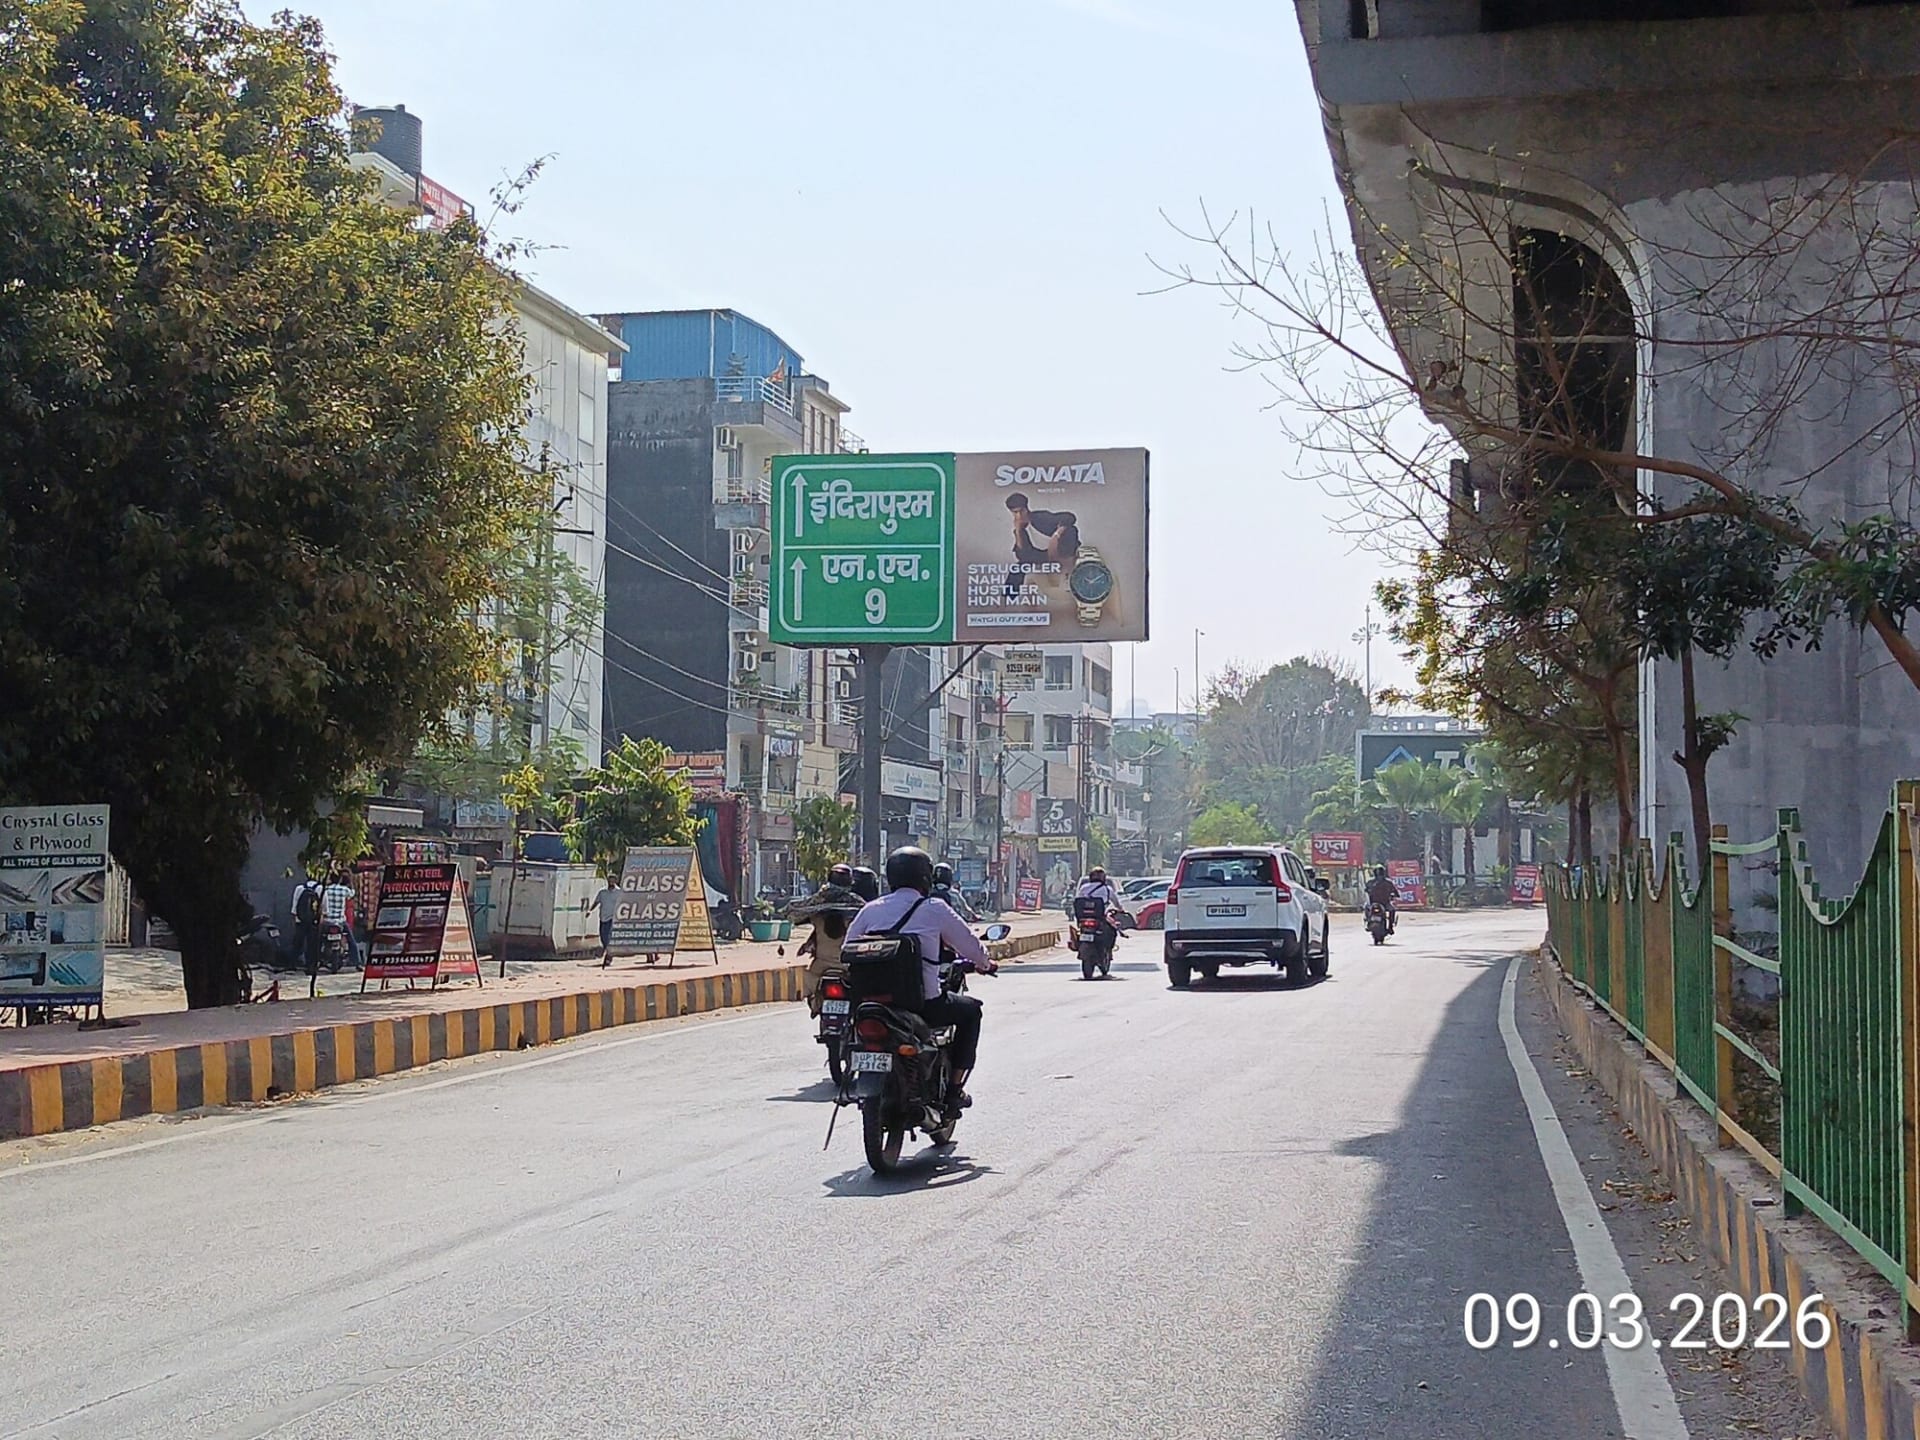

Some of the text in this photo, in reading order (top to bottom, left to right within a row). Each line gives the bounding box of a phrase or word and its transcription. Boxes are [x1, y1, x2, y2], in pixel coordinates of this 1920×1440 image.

[994, 461, 1106, 487] SONATA
[808, 478, 935, 536] इंदिरापुरम
[820, 554, 930, 584] एन.एच.
[967, 563, 1062, 574] STRUGGLER
[967, 574, 1007, 585] NAHI
[967, 584, 1039, 596] HUSTLER
[864, 588, 887, 625] 9
[967, 594, 1048, 607] HUN MAIN
[970, 614, 1047, 624] WATCH OUT FOR US
[1045, 800, 1064, 820] 5
[1042, 818, 1073, 834] SEAS
[13, 833, 92, 852] & Plywood
[1313, 838, 1351, 854] गुप्ता
[3, 855, 102, 867] ALL TYPES OF GLASS WORKS
[413, 867, 443, 879] STEEL
[622, 874, 687, 893] GLASS
[615, 902, 682, 921] GLASS
